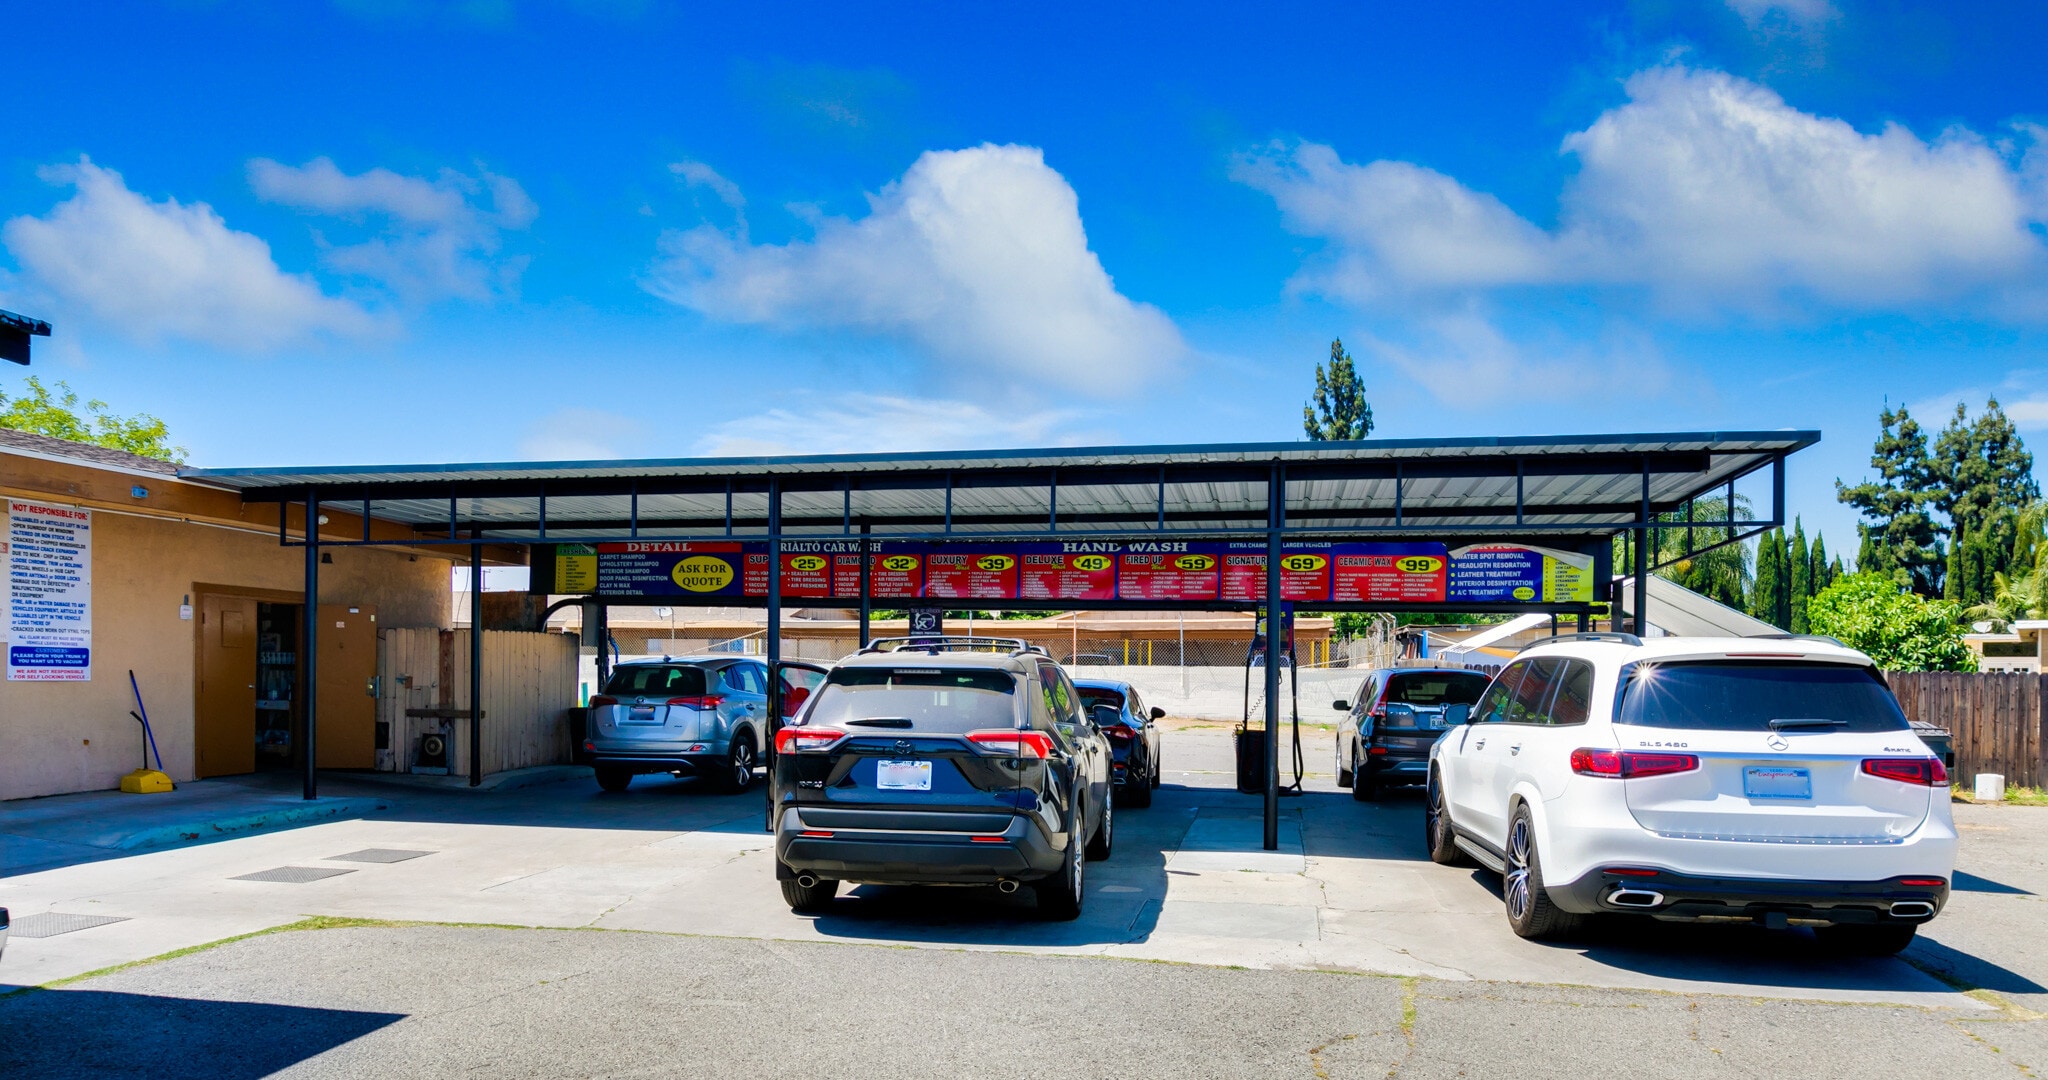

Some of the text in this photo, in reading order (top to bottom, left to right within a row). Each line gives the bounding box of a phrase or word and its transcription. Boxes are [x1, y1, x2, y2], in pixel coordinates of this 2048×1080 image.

[29, 506, 72, 518] RESPONSIBLE
[627, 543, 692, 552] DETAIL
[780, 543, 820, 552] RIALTO
[823, 543, 845, 552] CAR
[1063, 542, 1188, 552] HAND WASH
[837, 556, 876, 565] DIAMD
[930, 555, 968, 565] LUXURY
[1025, 555, 1064, 564] DELUXE
[1125, 555, 1163, 564] FIRED UP
[1227, 556, 1267, 565] SIGNATUR
[1338, 557, 1392, 567] CERAMIC WAX
[679, 565, 726, 573] ASK FOR
[683, 578, 722, 587] QUOTE
